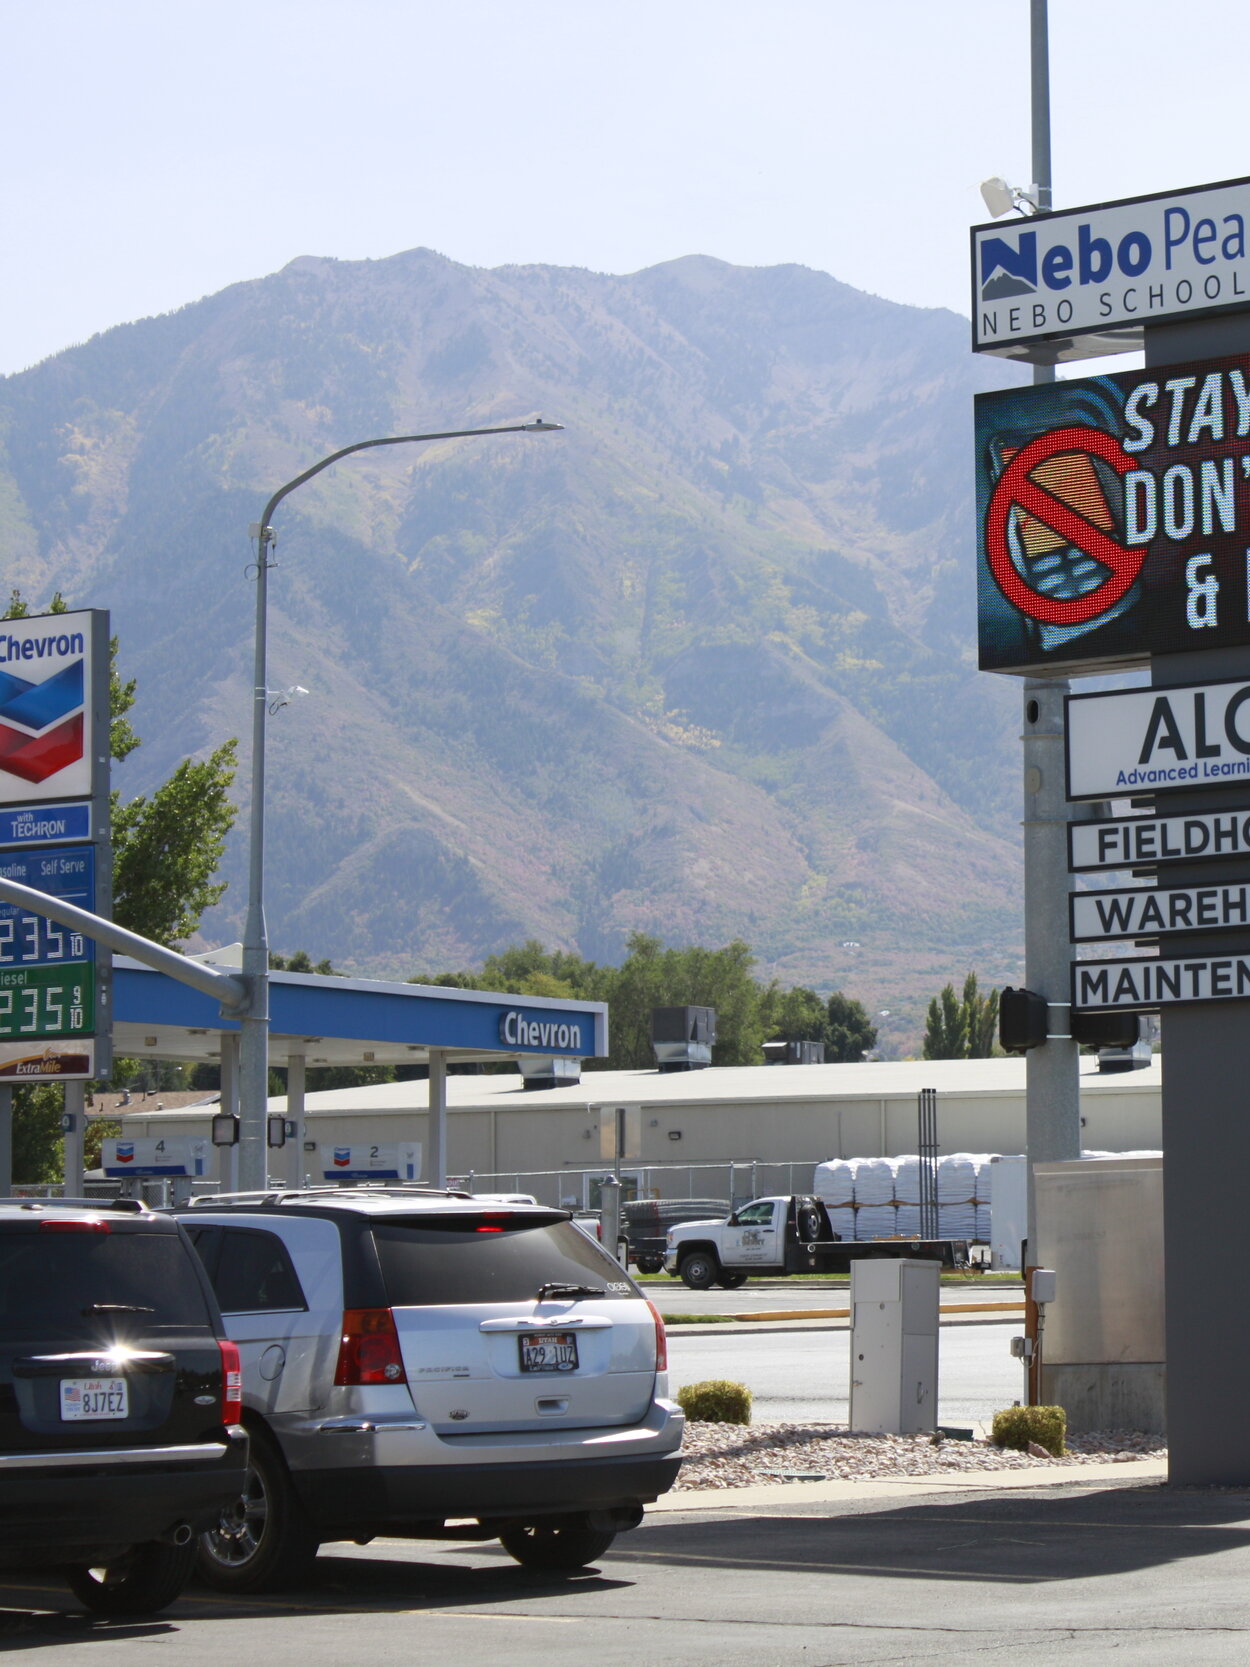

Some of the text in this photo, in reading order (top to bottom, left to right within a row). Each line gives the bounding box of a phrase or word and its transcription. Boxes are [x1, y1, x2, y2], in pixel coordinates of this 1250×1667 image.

[981, 223, 1153, 291] Nebo
[982, 299, 1073, 336] NEBO
[1099, 271, 1247, 317] SCHOOL
[1184, 553, 1219, 630] &
[1116, 762, 1198, 786] Advanced
[17, 812, 34, 823] with
[11, 820, 65, 838] TECHRON
[41, 860, 57, 876] Self
[60, 859, 85, 874] Serve
[504, 1011, 580, 1048] Chevron
[16, 1060, 61, 1074] ExtraMile
[155, 1140, 165, 1153] 4
[370, 1146, 379, 1158] 2
[83, 1392, 124, 1413] 8J7EZ
